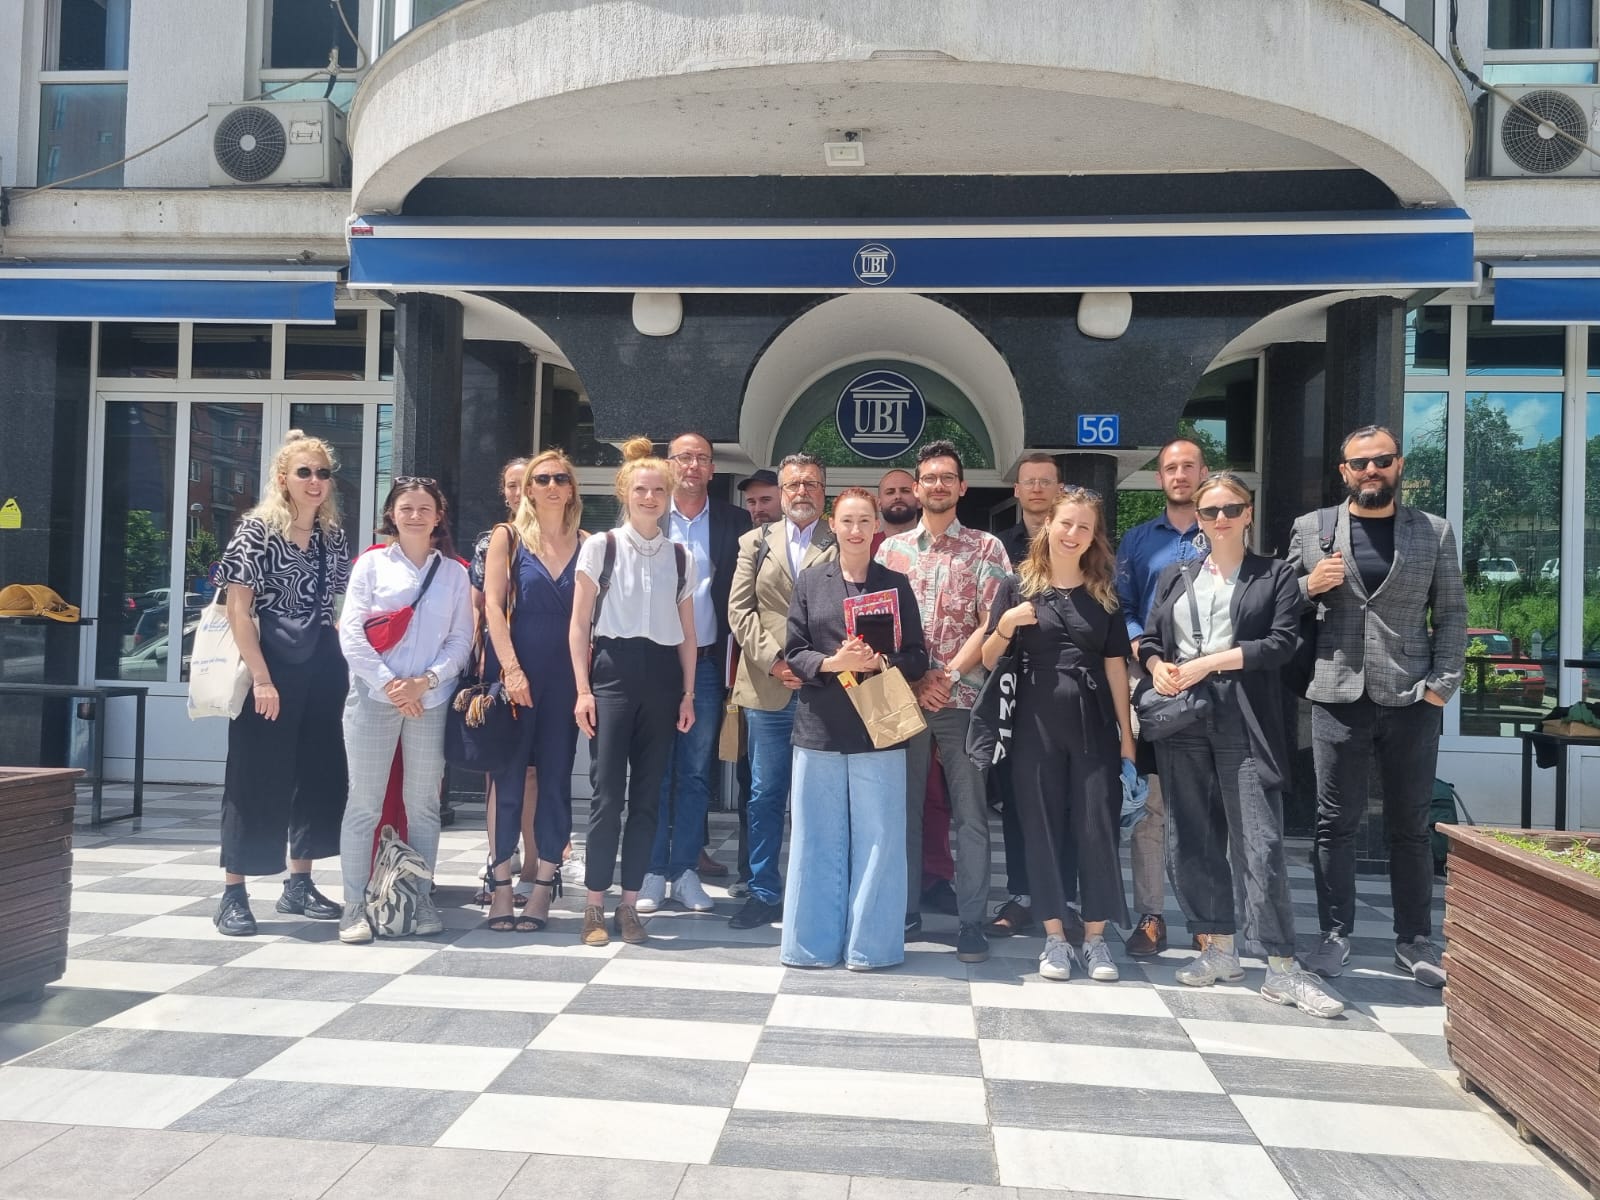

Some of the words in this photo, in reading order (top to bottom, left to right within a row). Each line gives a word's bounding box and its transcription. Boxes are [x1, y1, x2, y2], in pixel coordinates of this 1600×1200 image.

[861, 256, 888, 273] UBT
[854, 399, 910, 433] UBT
[1082, 417, 1114, 443] 56
